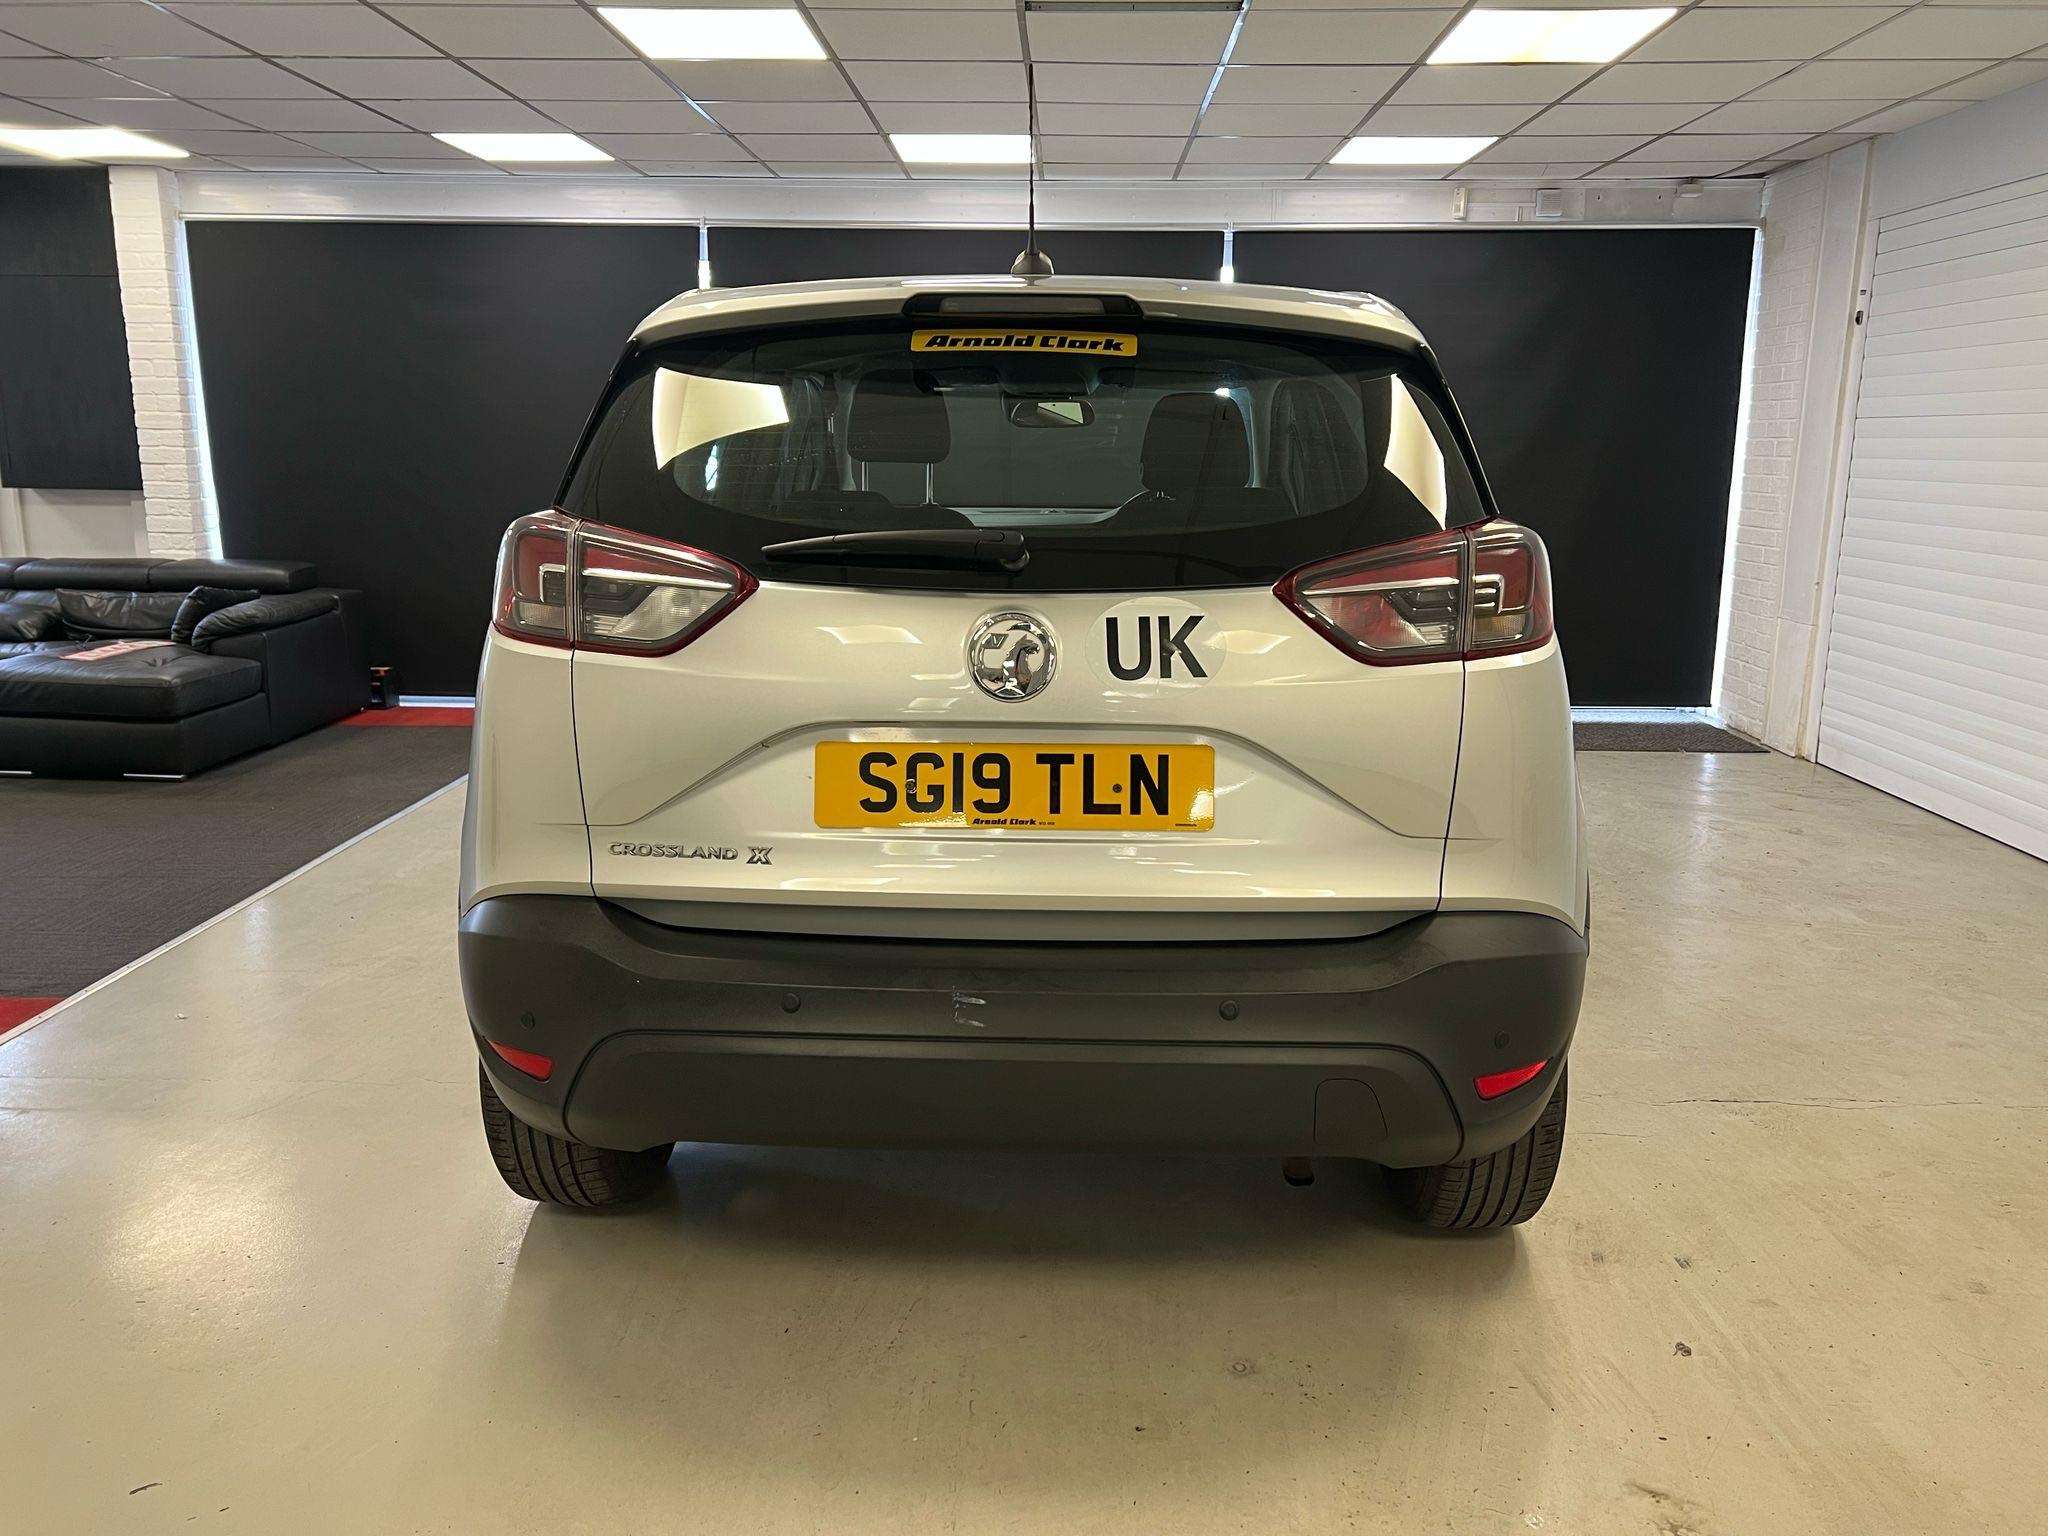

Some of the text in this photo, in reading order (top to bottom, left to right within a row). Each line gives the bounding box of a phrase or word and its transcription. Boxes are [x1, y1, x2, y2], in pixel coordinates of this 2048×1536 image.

[925, 334, 1125, 352] Arnold Clark
[1105, 615, 1208, 681] UK
[859, 751, 1169, 816] SG19 TLN
[971, 818, 1008, 826] Arnold
[1009, 818, 1037, 826] Clark
[608, 841, 775, 866] CROSSLAND X
